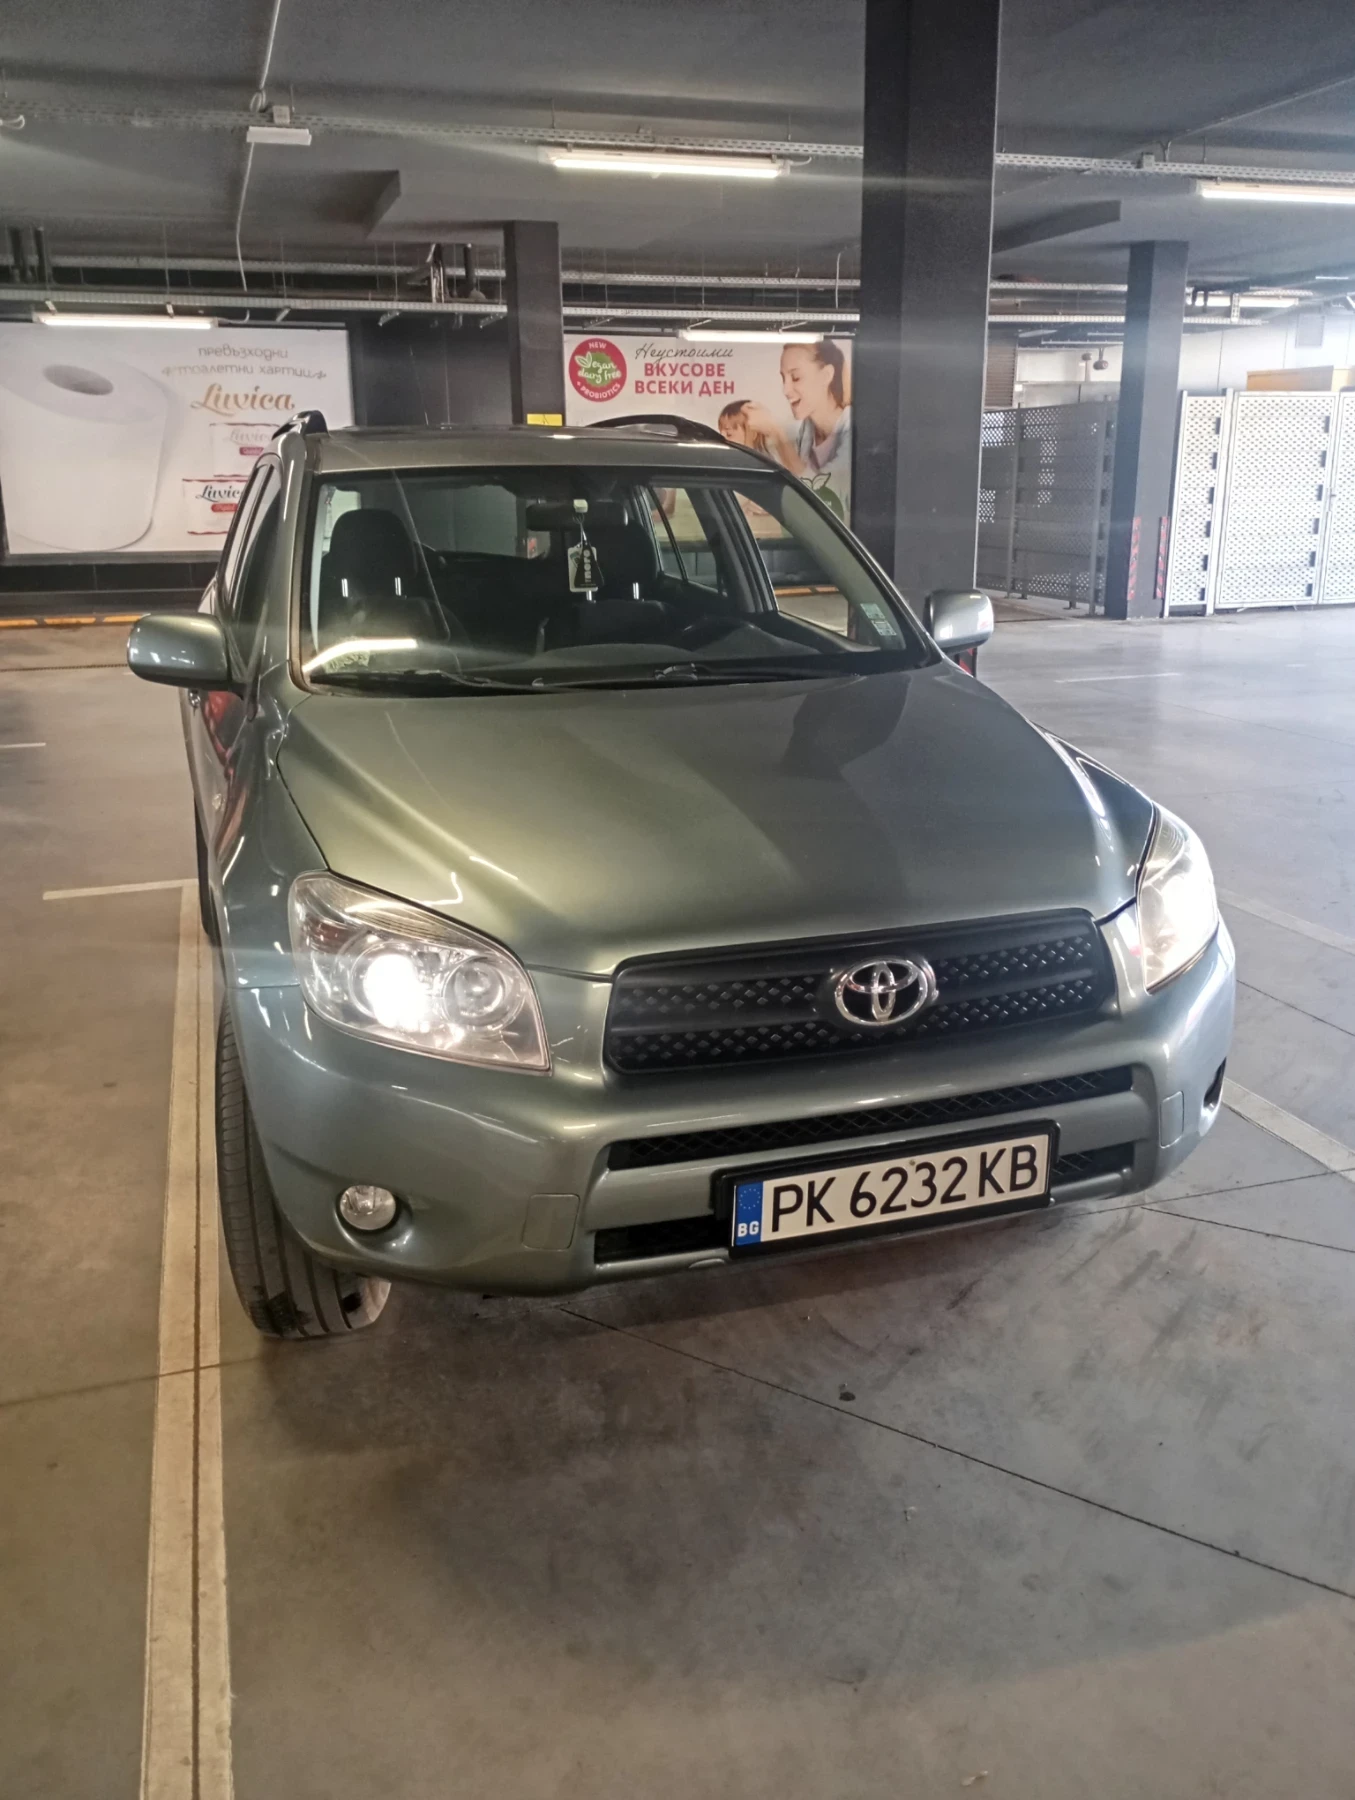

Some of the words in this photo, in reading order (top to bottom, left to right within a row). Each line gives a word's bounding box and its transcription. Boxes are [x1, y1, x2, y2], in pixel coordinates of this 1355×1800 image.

[198, 343, 289, 361] превъзходни
[635, 343, 733, 369] Неустоими
[575, 351, 617, 374] Vegan
[644, 363, 726, 377] ВКУСОВЕ
[259, 365, 316, 378] хартии
[578, 367, 602, 384] dairy
[604, 370, 621, 381] free
[580, 382, 621, 399] PROBIOTICS
[635, 380, 693, 394] ВСЕКИ
[698, 381, 735, 397] ДЕН
[190, 383, 296, 417] Luvica
[222, 428, 270, 446] Luvic
[195, 485, 242, 502] Luvic
[771, 1176, 836, 1233] PK
[849, 1156, 968, 1219] 6232
[978, 1144, 1038, 1198] KB
[738, 1221, 760, 1237] BG
